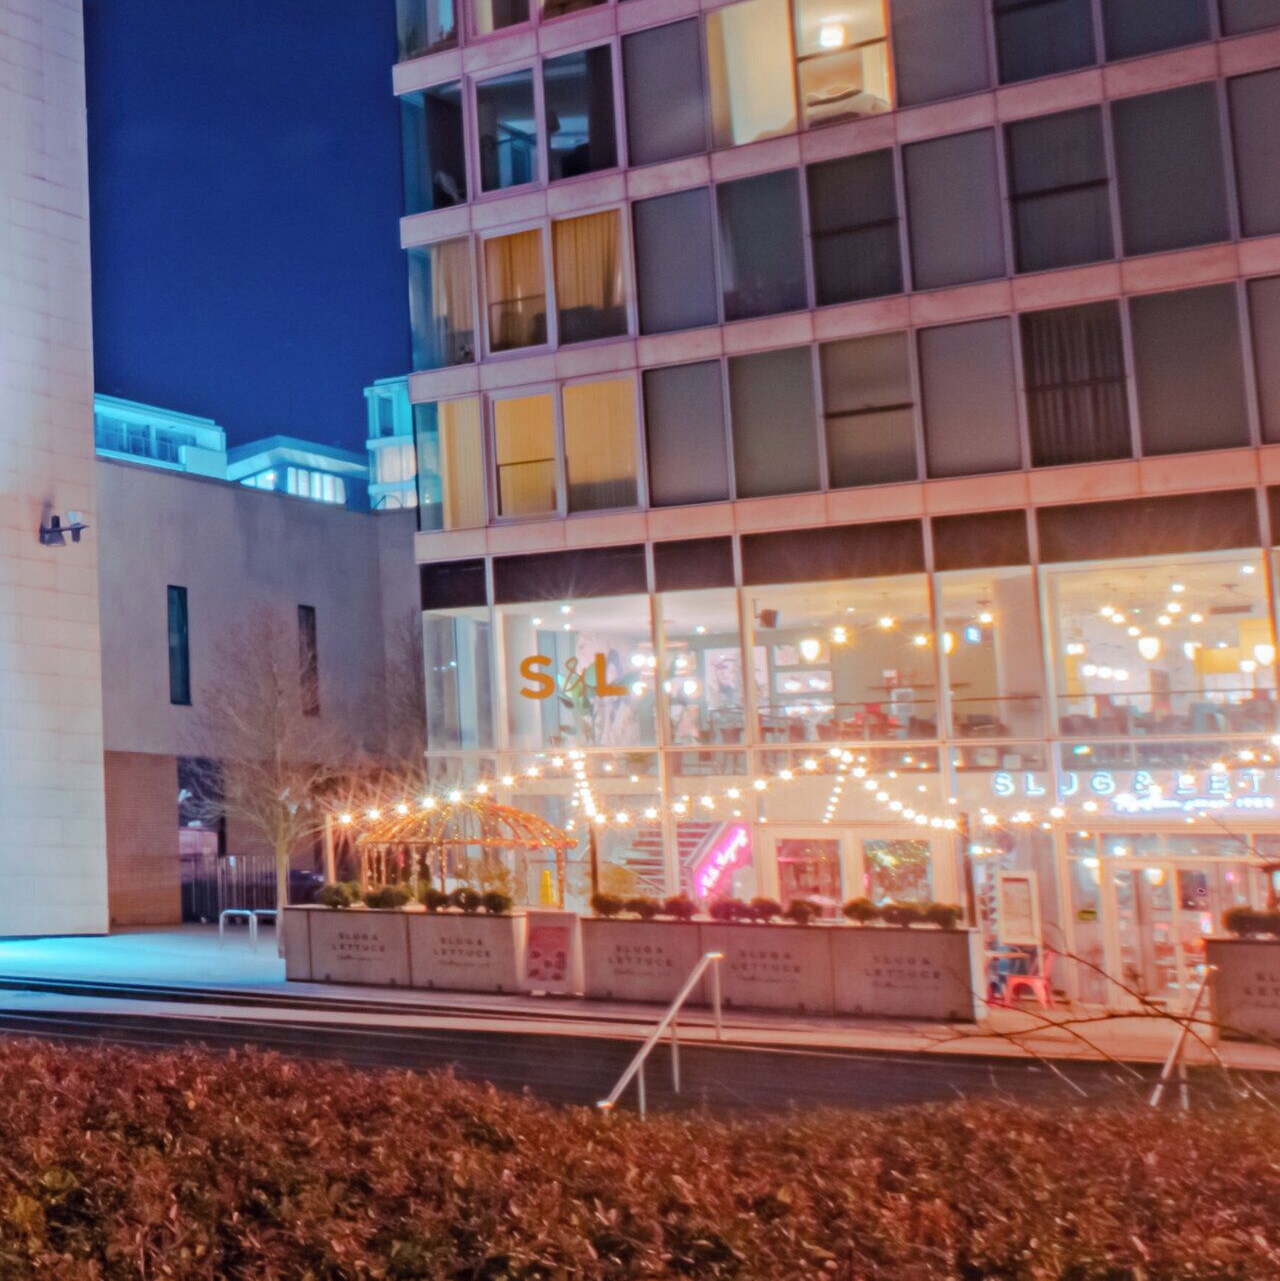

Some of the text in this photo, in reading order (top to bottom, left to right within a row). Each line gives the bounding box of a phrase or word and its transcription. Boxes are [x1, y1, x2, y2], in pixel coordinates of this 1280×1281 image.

[994, 770, 1116, 796] SLUG
[331, 943, 387, 953] LETTUCE
[433, 947, 492, 958] LETTUCE
[607, 955, 673, 967] LETTUCE
